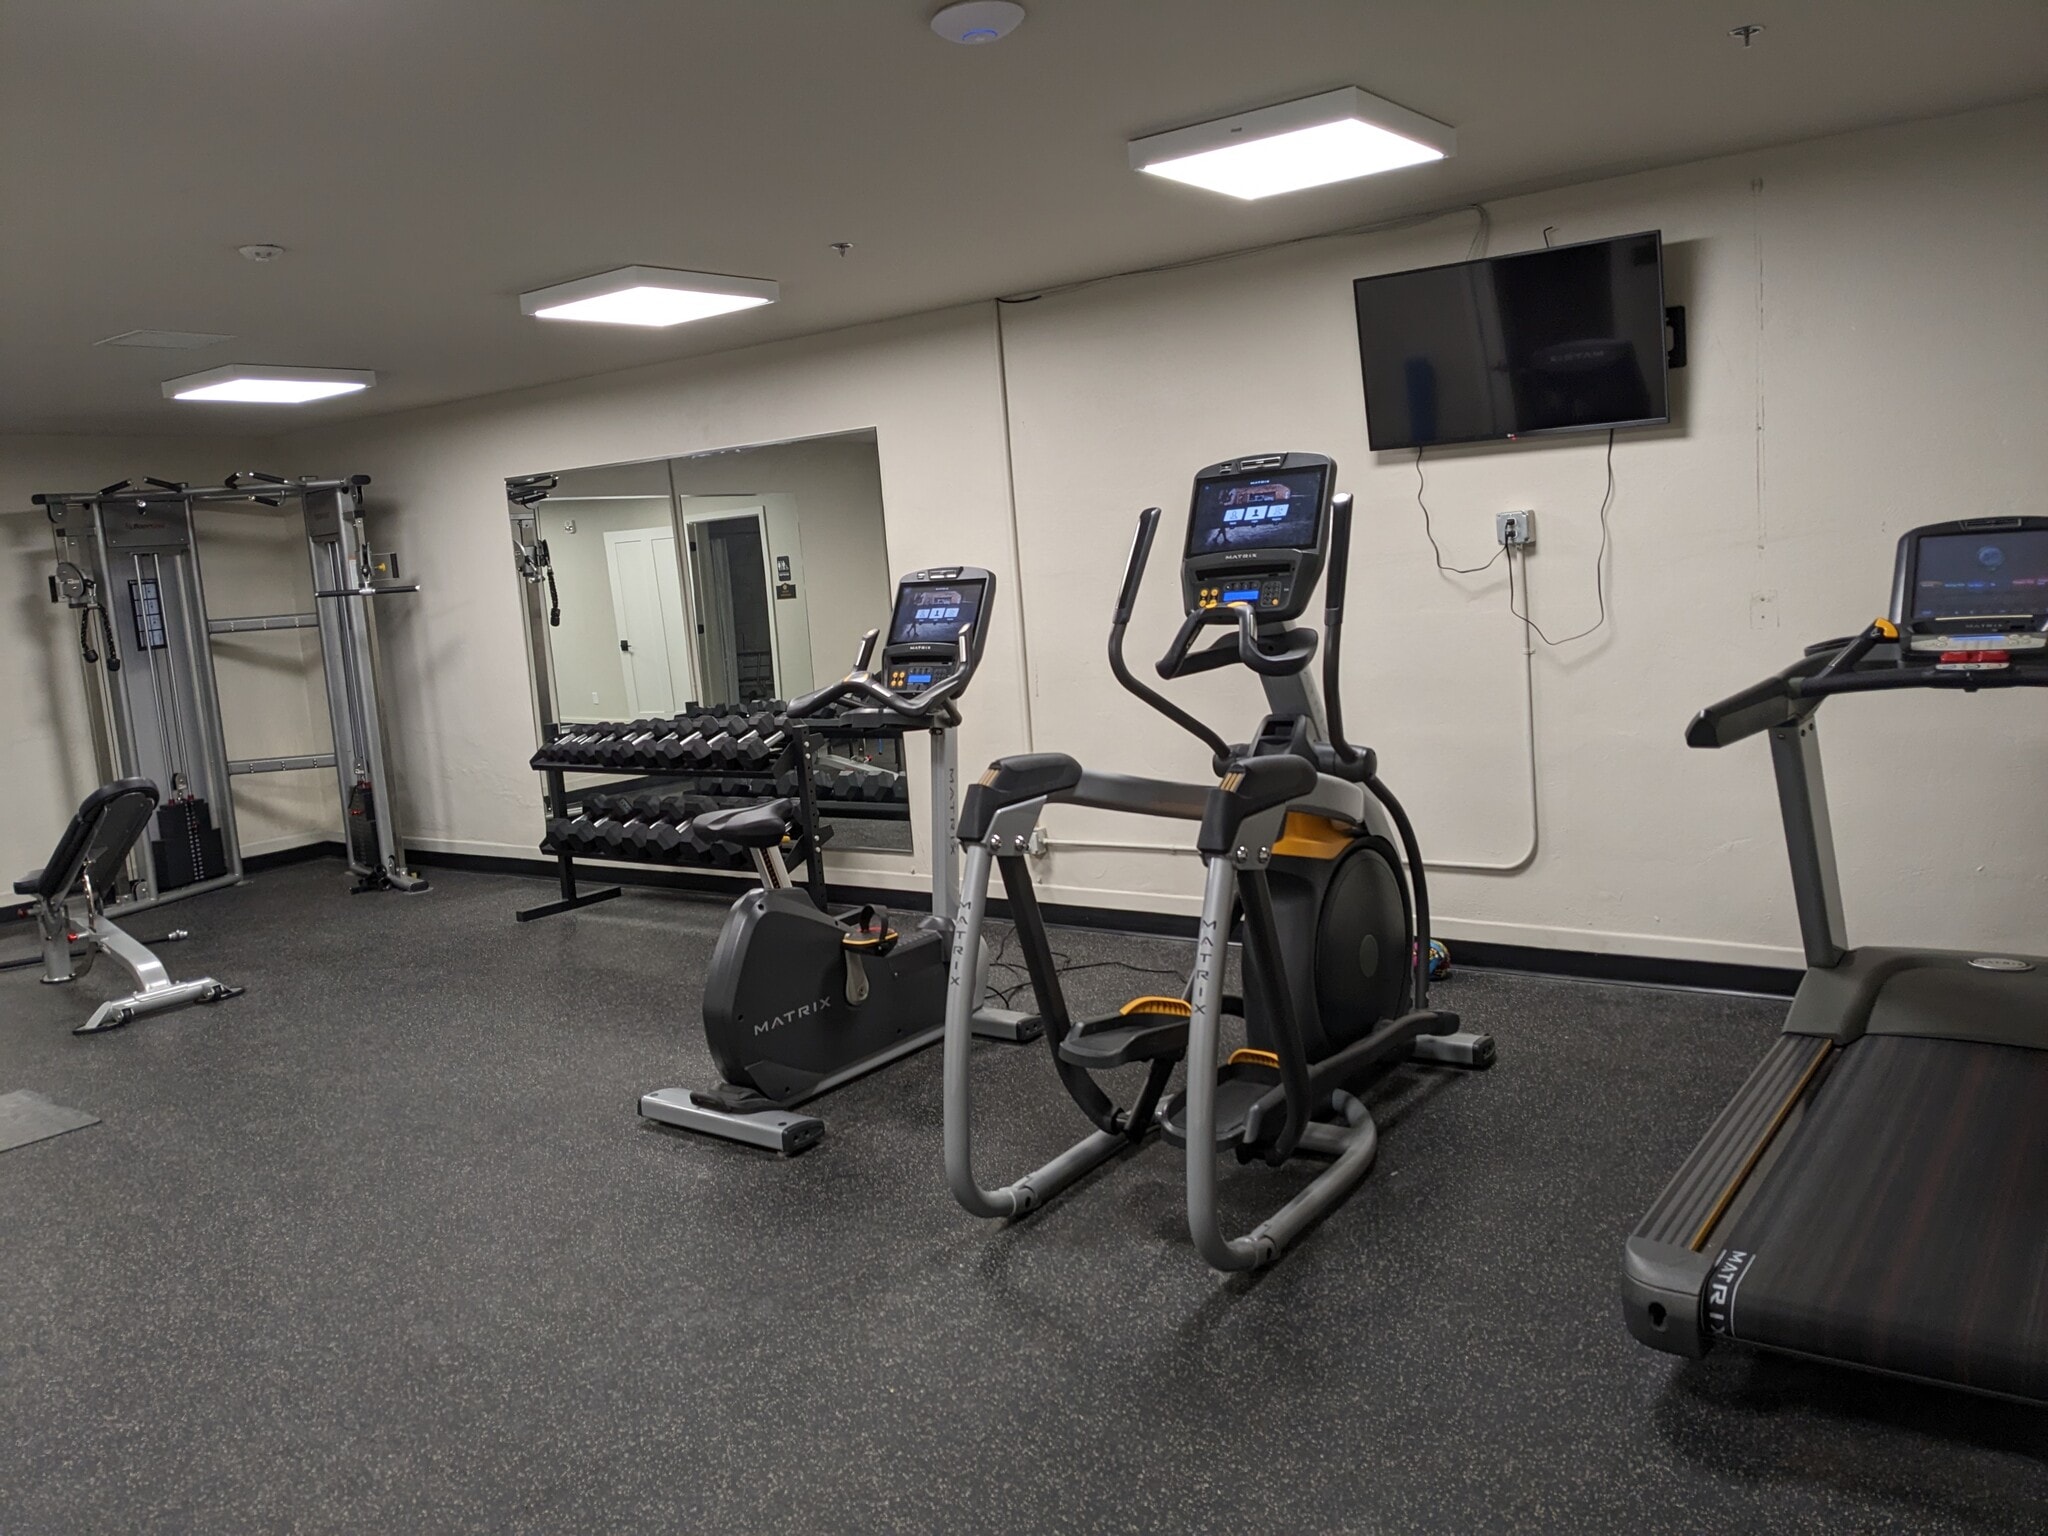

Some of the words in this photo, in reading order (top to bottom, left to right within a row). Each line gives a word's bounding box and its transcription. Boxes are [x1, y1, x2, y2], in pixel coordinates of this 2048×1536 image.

[950, 901, 971, 986] MATRIX
[1194, 920, 1217, 1014] MATRIX
[754, 996, 831, 1036] MATRIX
[1709, 1250, 1748, 1335] MATRIX
